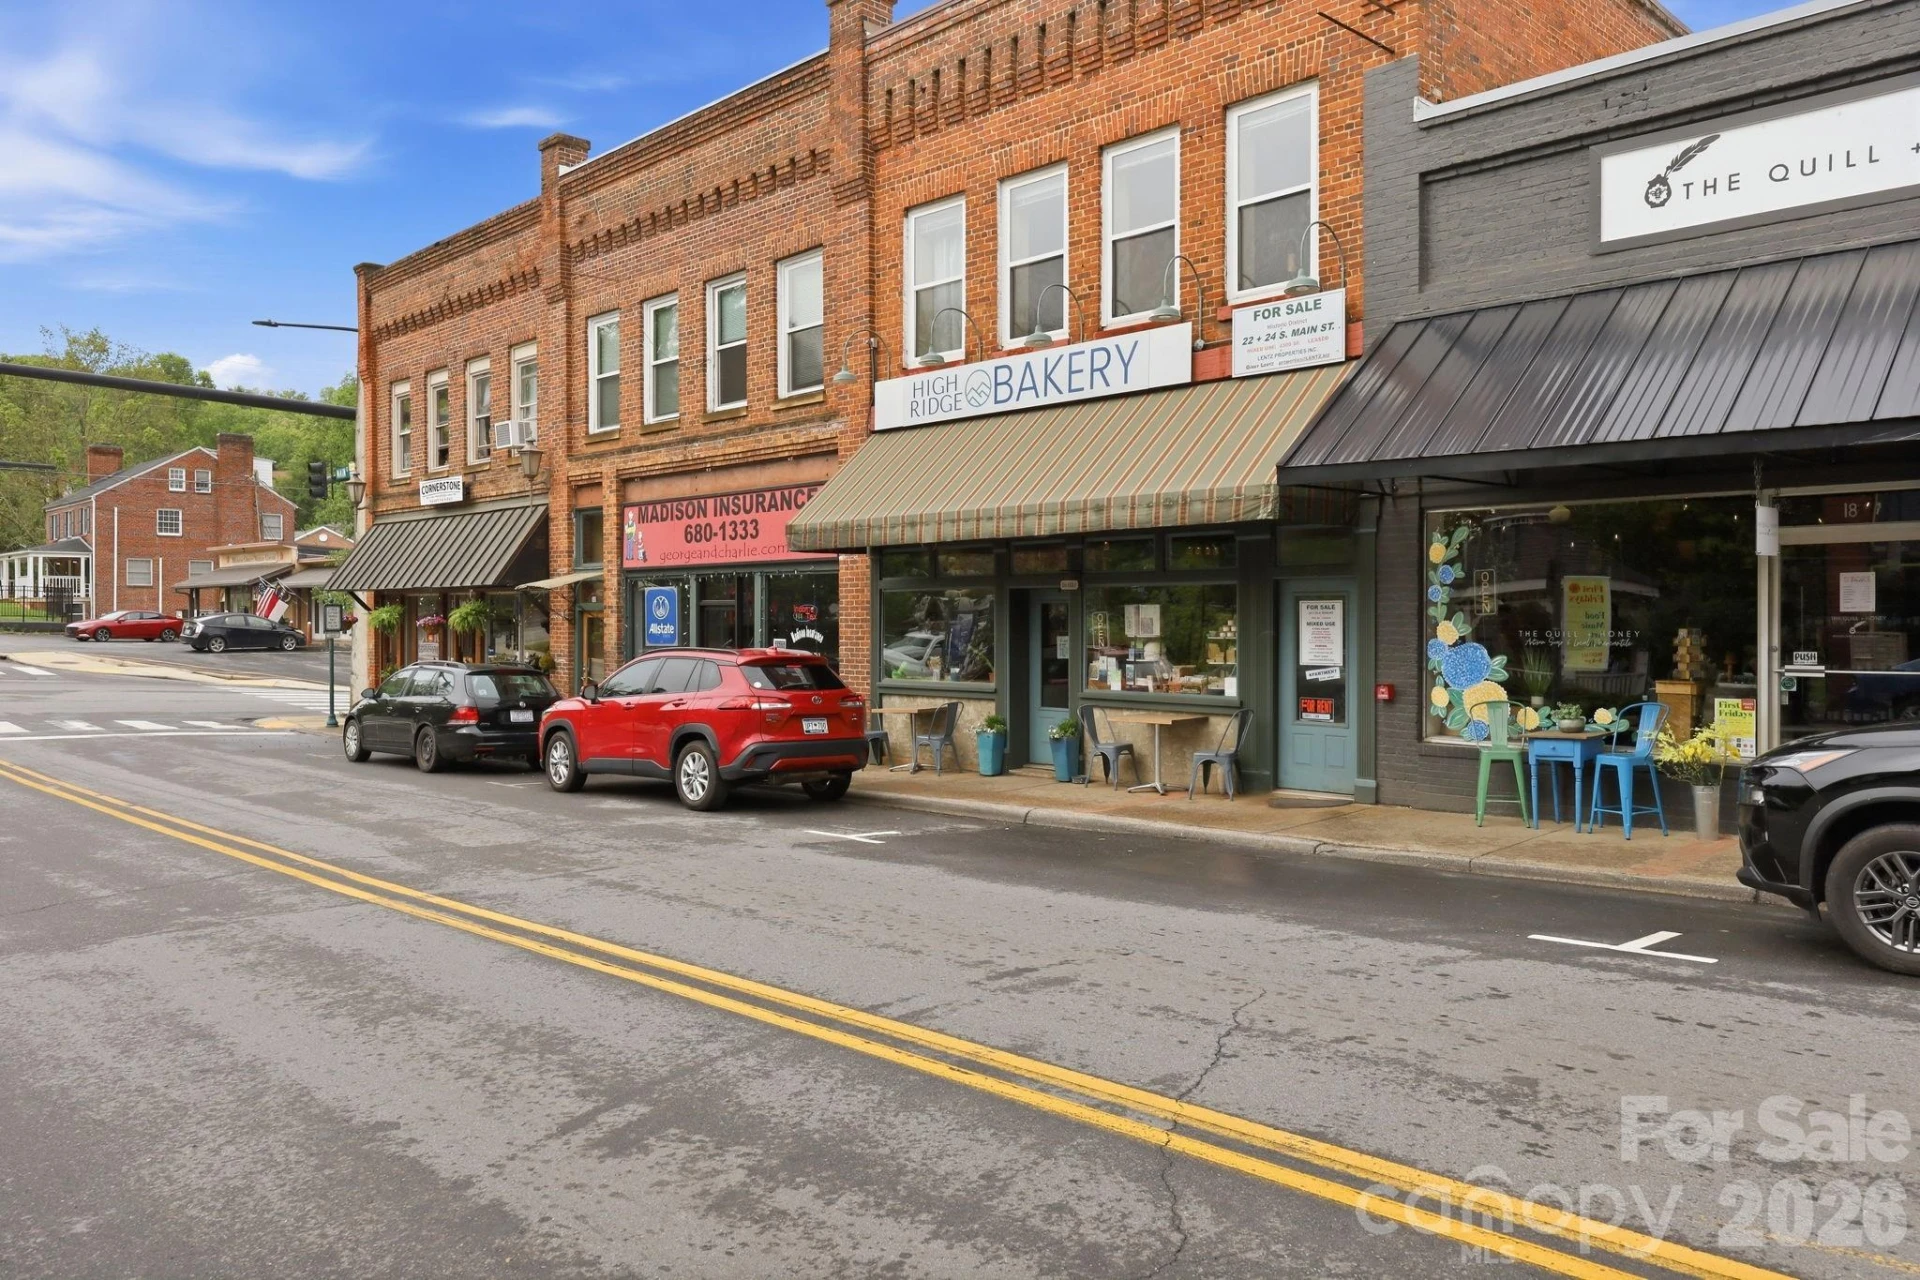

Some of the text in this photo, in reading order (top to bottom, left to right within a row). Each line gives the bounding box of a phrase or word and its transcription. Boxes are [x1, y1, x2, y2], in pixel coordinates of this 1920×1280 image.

[1683, 143, 1920, 200] THE QUILL +
[1253, 298, 1322, 321] FOR SALE
[1241, 336, 1254, 346] 22
[1264, 332, 1277, 342] 24
[1279, 330, 1288, 340] S.
[1291, 325, 1318, 337] MAIN
[1321, 322, 1335, 332] ST.
[1274, 348, 1307, 358] PROPERTIES
[993, 340, 1139, 405] BAKERY
[913, 373, 958, 399] HIGH
[910, 392, 963, 418] RIDGE
[421, 481, 461, 495] CORNERSTONE
[637, 487, 818, 525] MADISON INSURANCE
[1844, 502, 1858, 518] 18
[684, 518, 760, 544] 680-1333
[1481, 571, 1490, 613] OPEN
[648, 623, 675, 634] Allstate
[1097, 613, 1105, 647] OPEN
[1519, 630, 1538, 638] THE
[1545, 630, 1578, 638] QUILL
[1794, 652, 1816, 661] PUSH
[1301, 699, 1333, 714] FOR RENT
[1719, 709, 1753, 719] Fridays
